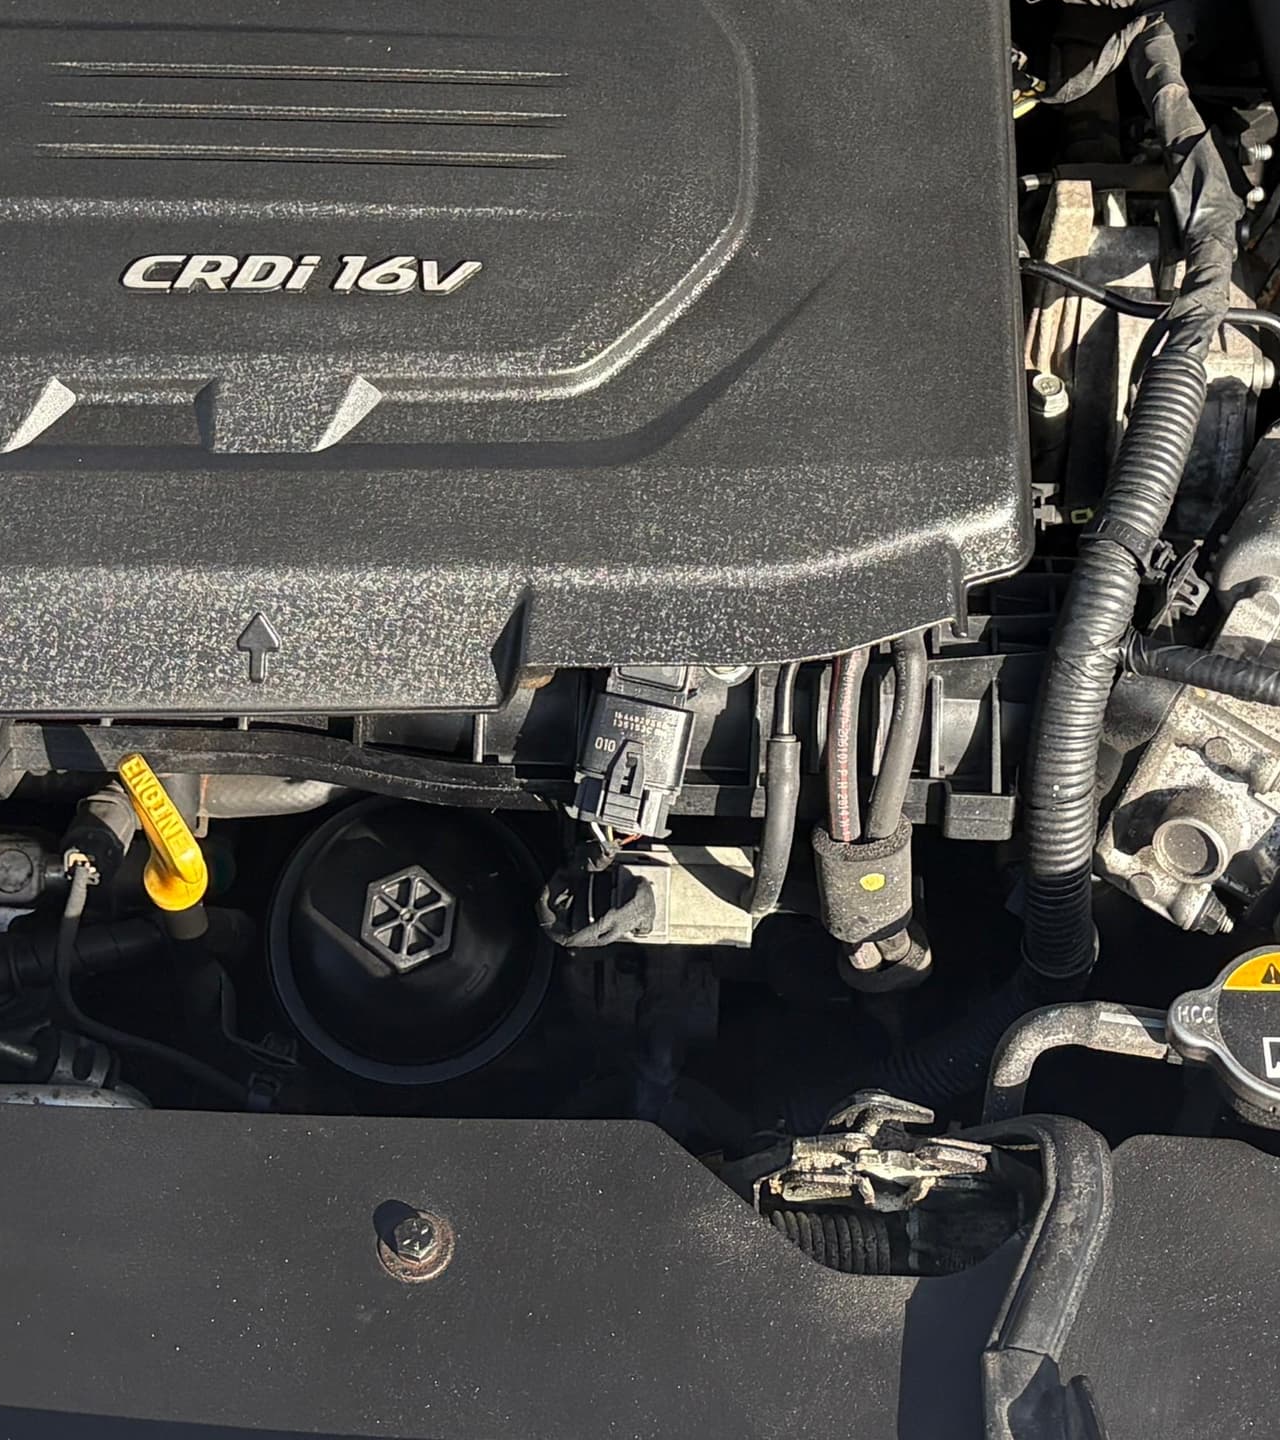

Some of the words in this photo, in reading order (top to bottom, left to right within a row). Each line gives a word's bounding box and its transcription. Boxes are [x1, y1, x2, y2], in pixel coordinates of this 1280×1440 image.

[121, 254, 320, 293] CRDi
[331, 254, 482, 295] 16V
[594, 736, 617, 753] 010
[122, 757, 195, 855] ENGINE
[1177, 1004, 1215, 1025] HCC
